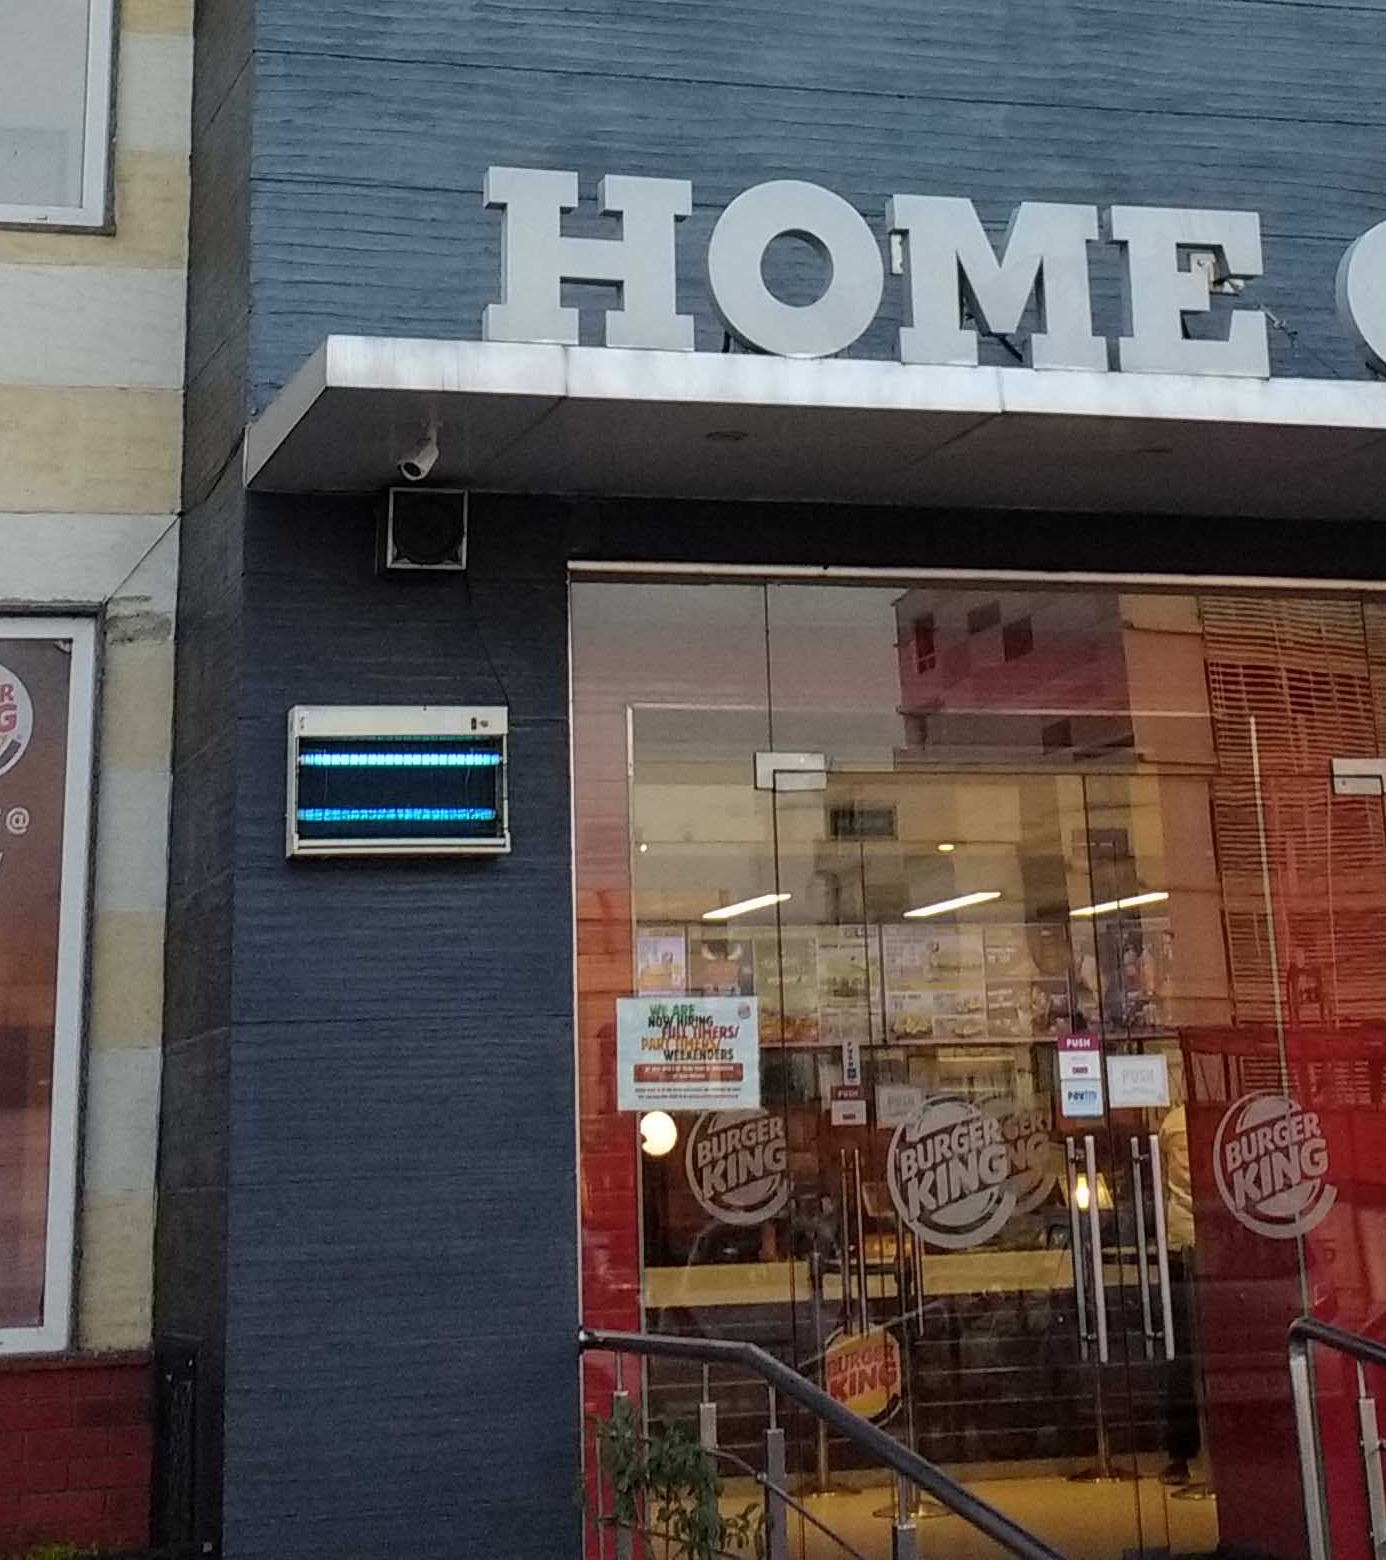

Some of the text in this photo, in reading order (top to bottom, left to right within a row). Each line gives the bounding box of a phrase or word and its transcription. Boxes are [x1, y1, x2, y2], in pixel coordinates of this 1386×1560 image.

[482, 165, 1270, 379] HOME
[6, 807, 30, 834] @
[1067, 1038, 1091, 1048] PUSH
[697, 1117, 786, 1168] BURGER
[702, 1139, 787, 1201] KING
[900, 1116, 1000, 1181] BURGER
[1225, 1111, 1321, 1173] BURGER
[905, 1143, 1010, 1220] KING
[1233, 1138, 1328, 1210] KING
[830, 1361, 897, 1401] KING
